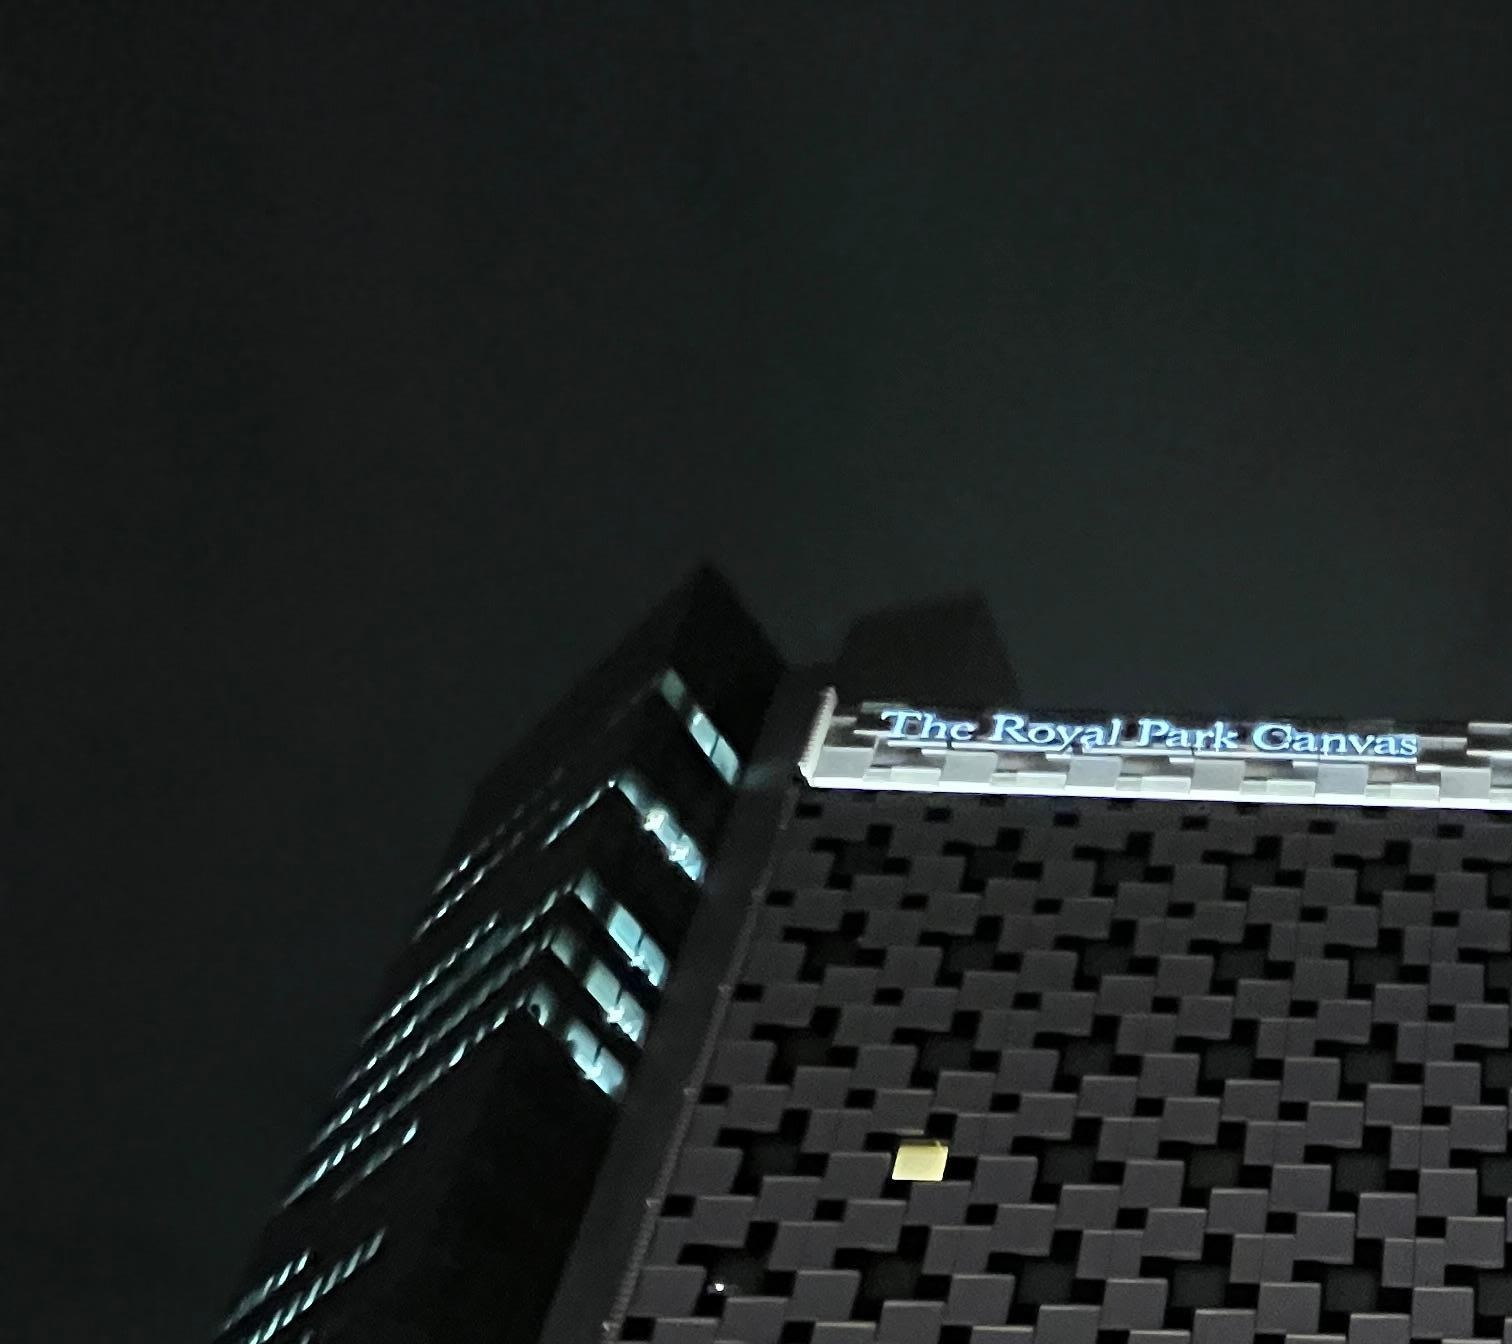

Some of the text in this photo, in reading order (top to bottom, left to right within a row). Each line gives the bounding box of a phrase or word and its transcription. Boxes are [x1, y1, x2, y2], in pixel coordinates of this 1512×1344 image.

[880, 709, 1419, 757] The Royal Park Canvas
